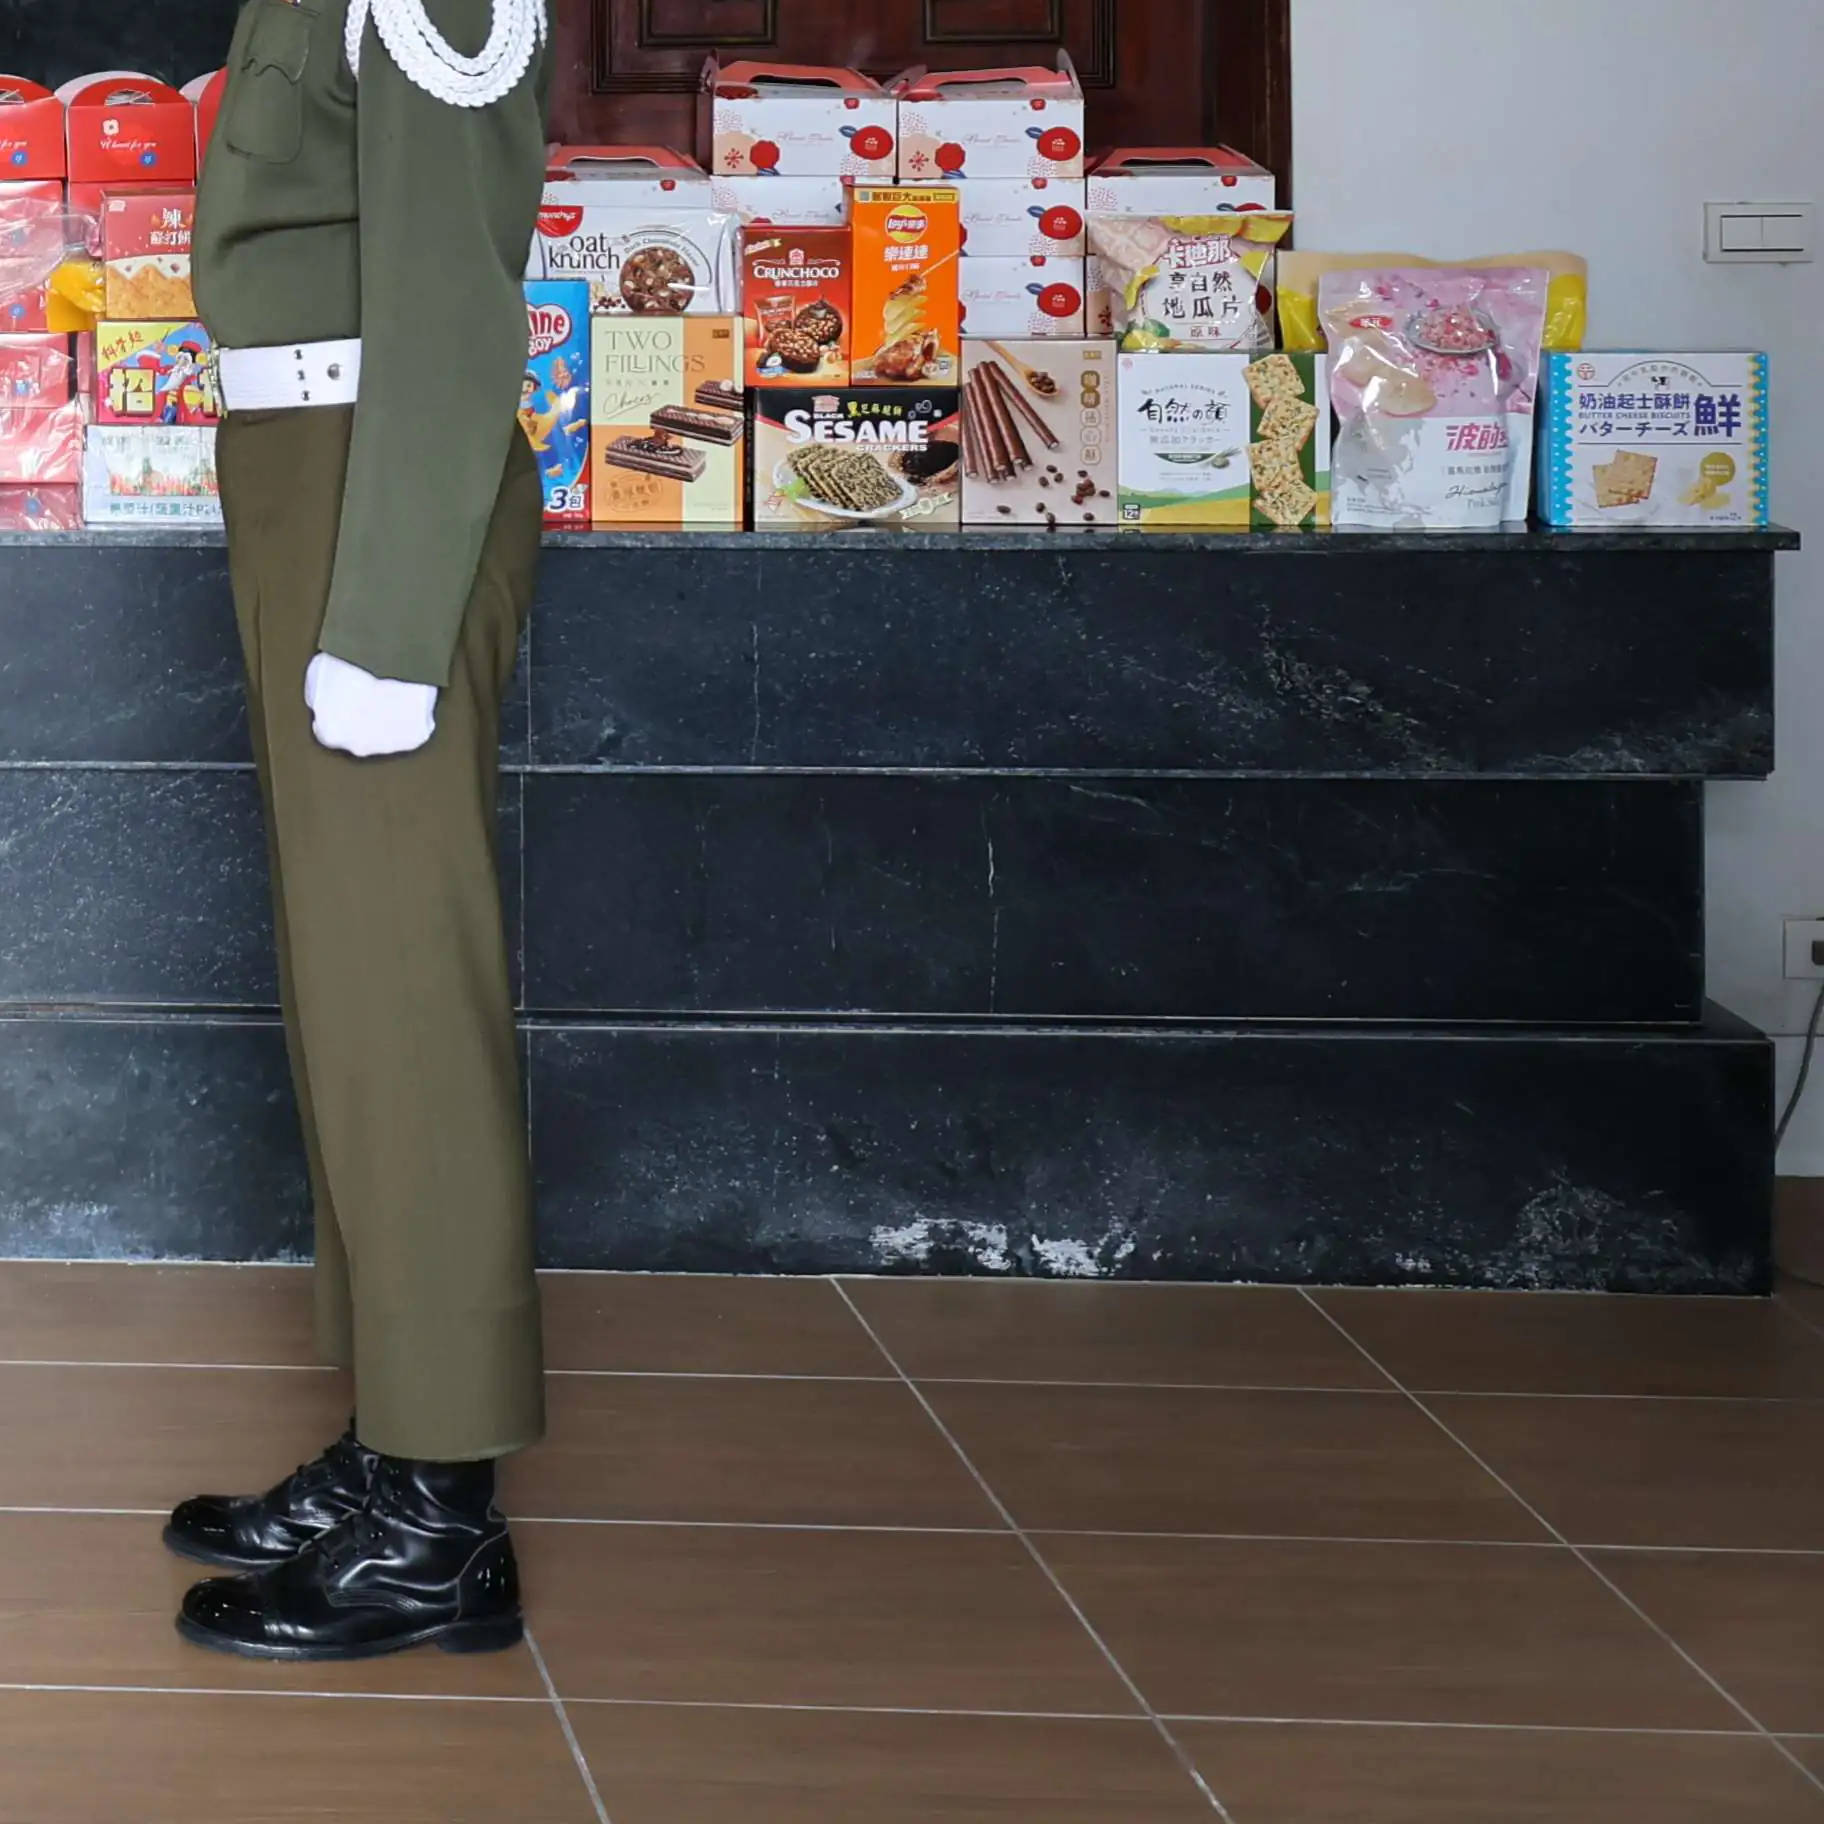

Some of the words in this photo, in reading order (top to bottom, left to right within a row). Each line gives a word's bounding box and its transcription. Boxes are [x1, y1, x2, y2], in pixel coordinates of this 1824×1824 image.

[569, 232, 606, 253] oat
[549, 245, 620, 270] krunch
[753, 265, 840, 280] CRUNCHOCO
[605, 330, 673, 351] TWO
[605, 355, 706, 373] FILLINGS
[1579, 393, 1690, 410] 奶油起士酥餅
[784, 409, 929, 443] SESAME
[1694, 393, 1741, 438] 鮮
[1579, 421, 1689, 437] バターチーズ
